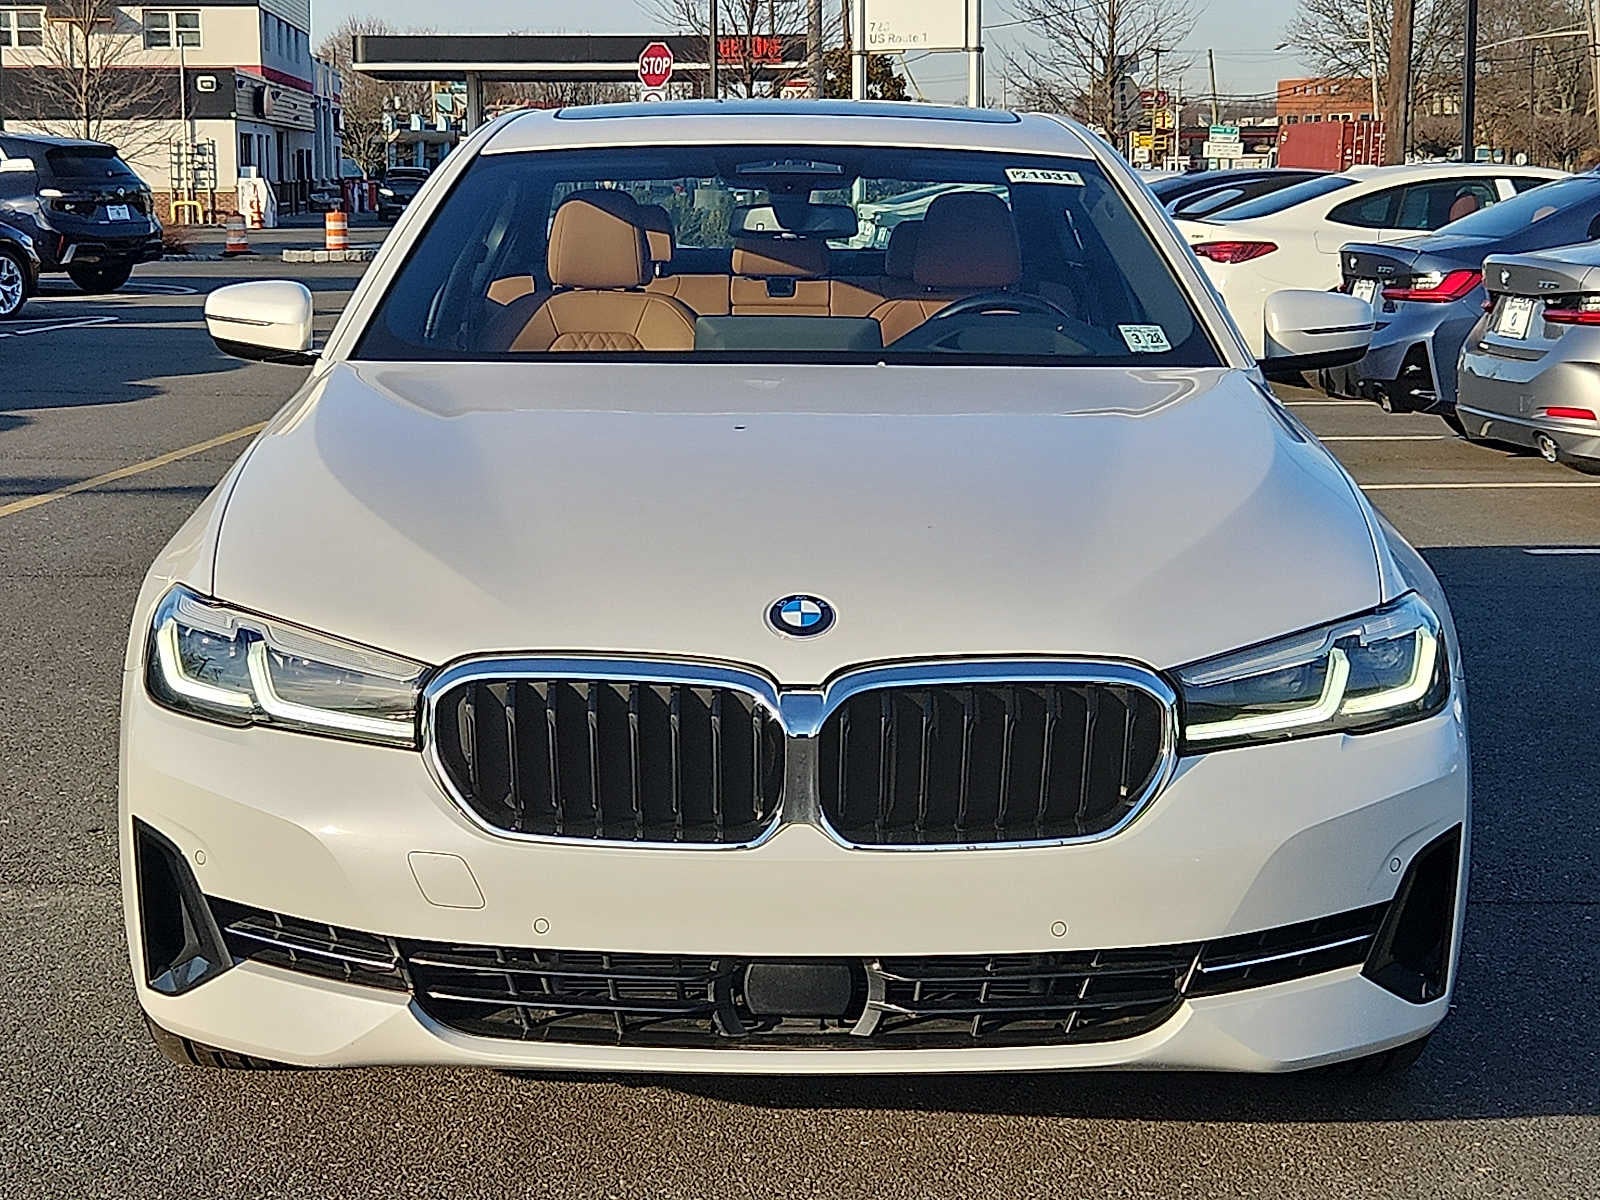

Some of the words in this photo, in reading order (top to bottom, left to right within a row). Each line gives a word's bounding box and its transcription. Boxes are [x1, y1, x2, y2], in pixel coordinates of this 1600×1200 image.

[870, 34, 885, 44] US
[641, 57, 671, 75] STOP
[1131, 333, 1142, 344] 3
[1147, 332, 1164, 344] 28
